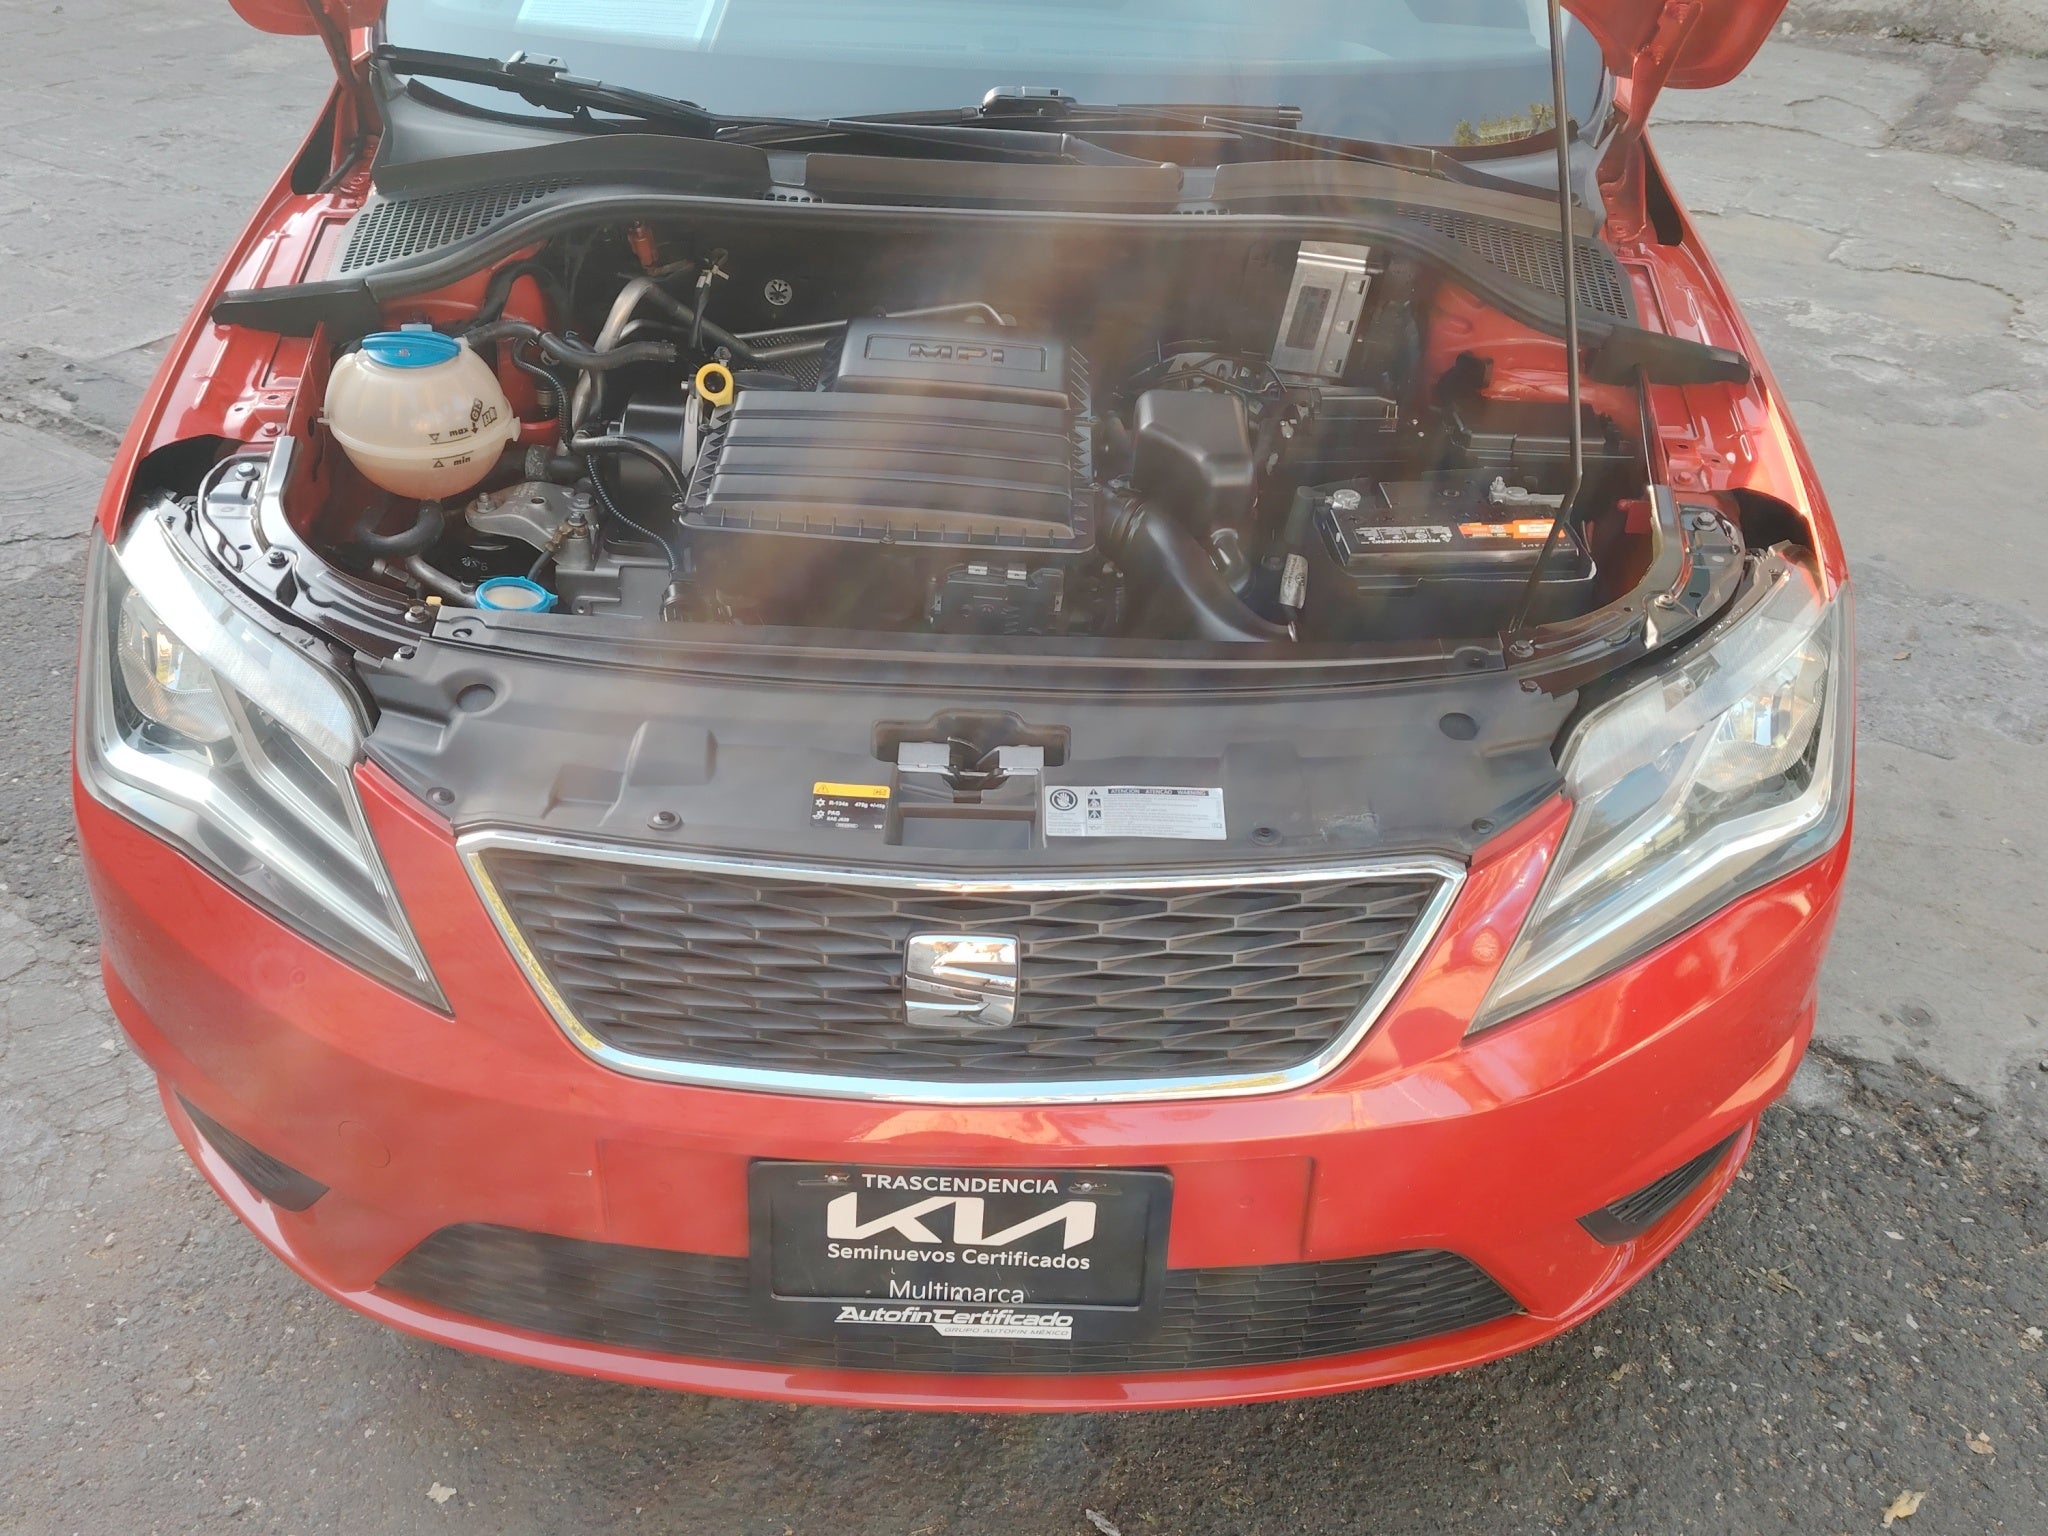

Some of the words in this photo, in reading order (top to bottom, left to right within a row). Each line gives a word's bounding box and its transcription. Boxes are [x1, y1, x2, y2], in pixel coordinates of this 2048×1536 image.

[449, 427, 469, 437] max
[454, 457, 470, 465] min
[862, 1173, 1059, 1194] TRASCENDENCIA
[827, 1192, 1097, 1251] KIA
[827, 1243, 956, 1264] Seminuevos
[962, 1249, 1091, 1270] Certificados
[889, 1280, 1025, 1305] Multimarca
